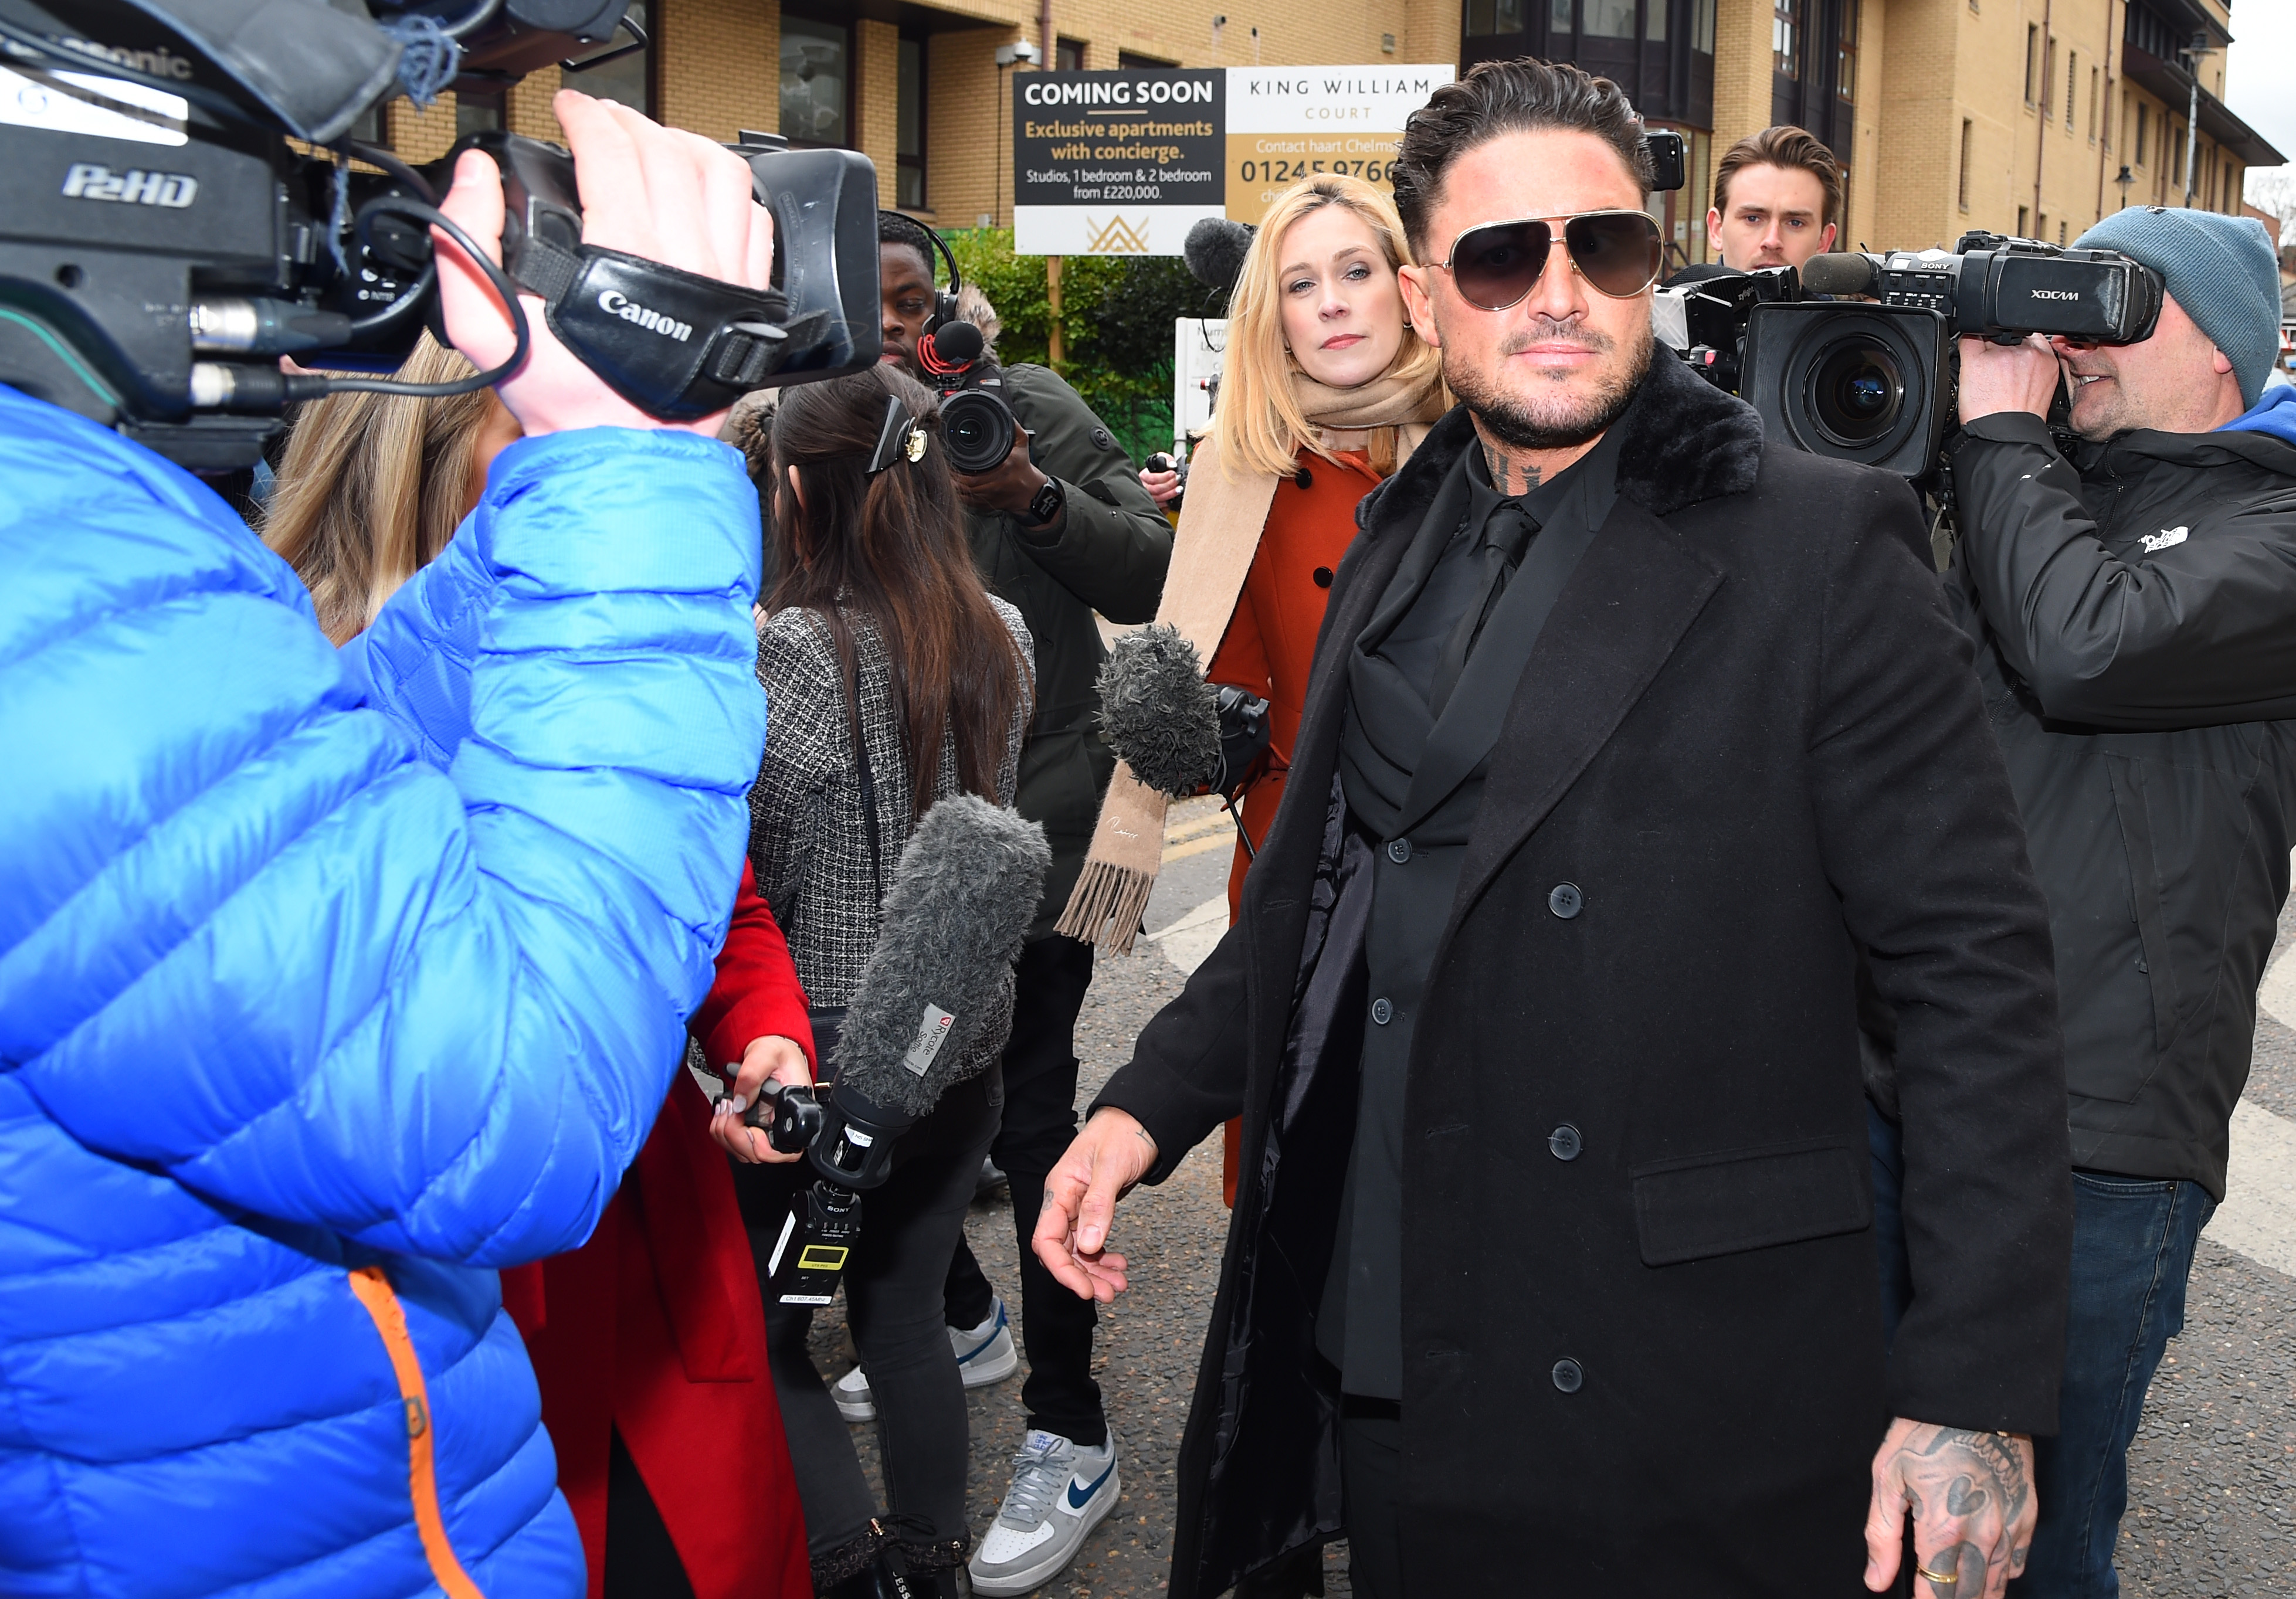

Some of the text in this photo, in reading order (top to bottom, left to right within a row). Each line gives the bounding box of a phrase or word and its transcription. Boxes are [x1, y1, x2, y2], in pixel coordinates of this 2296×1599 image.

[1025, 81, 1212, 105] COMING SOON
[1250, 80, 1428, 94] KING WILLIAM
[1305, 108, 1371, 119] COURT
[1025, 120, 1213, 142] Exclusive apartments
[1052, 142, 1185, 164] with concierge.
[1256, 139, 1305, 153] Contact
[1310, 138, 1341, 152] haart
[1026, 168, 1212, 184] Studios, 1 bedroom & 2 bedroom
[1073, 185, 1162, 200] from £220,000.
[2030, 290, 2080, 301] XDCAM
[598, 290, 693, 342] Canon
[911, 1031, 928, 1053] Softie
[923, 1025, 947, 1055] Rycote
